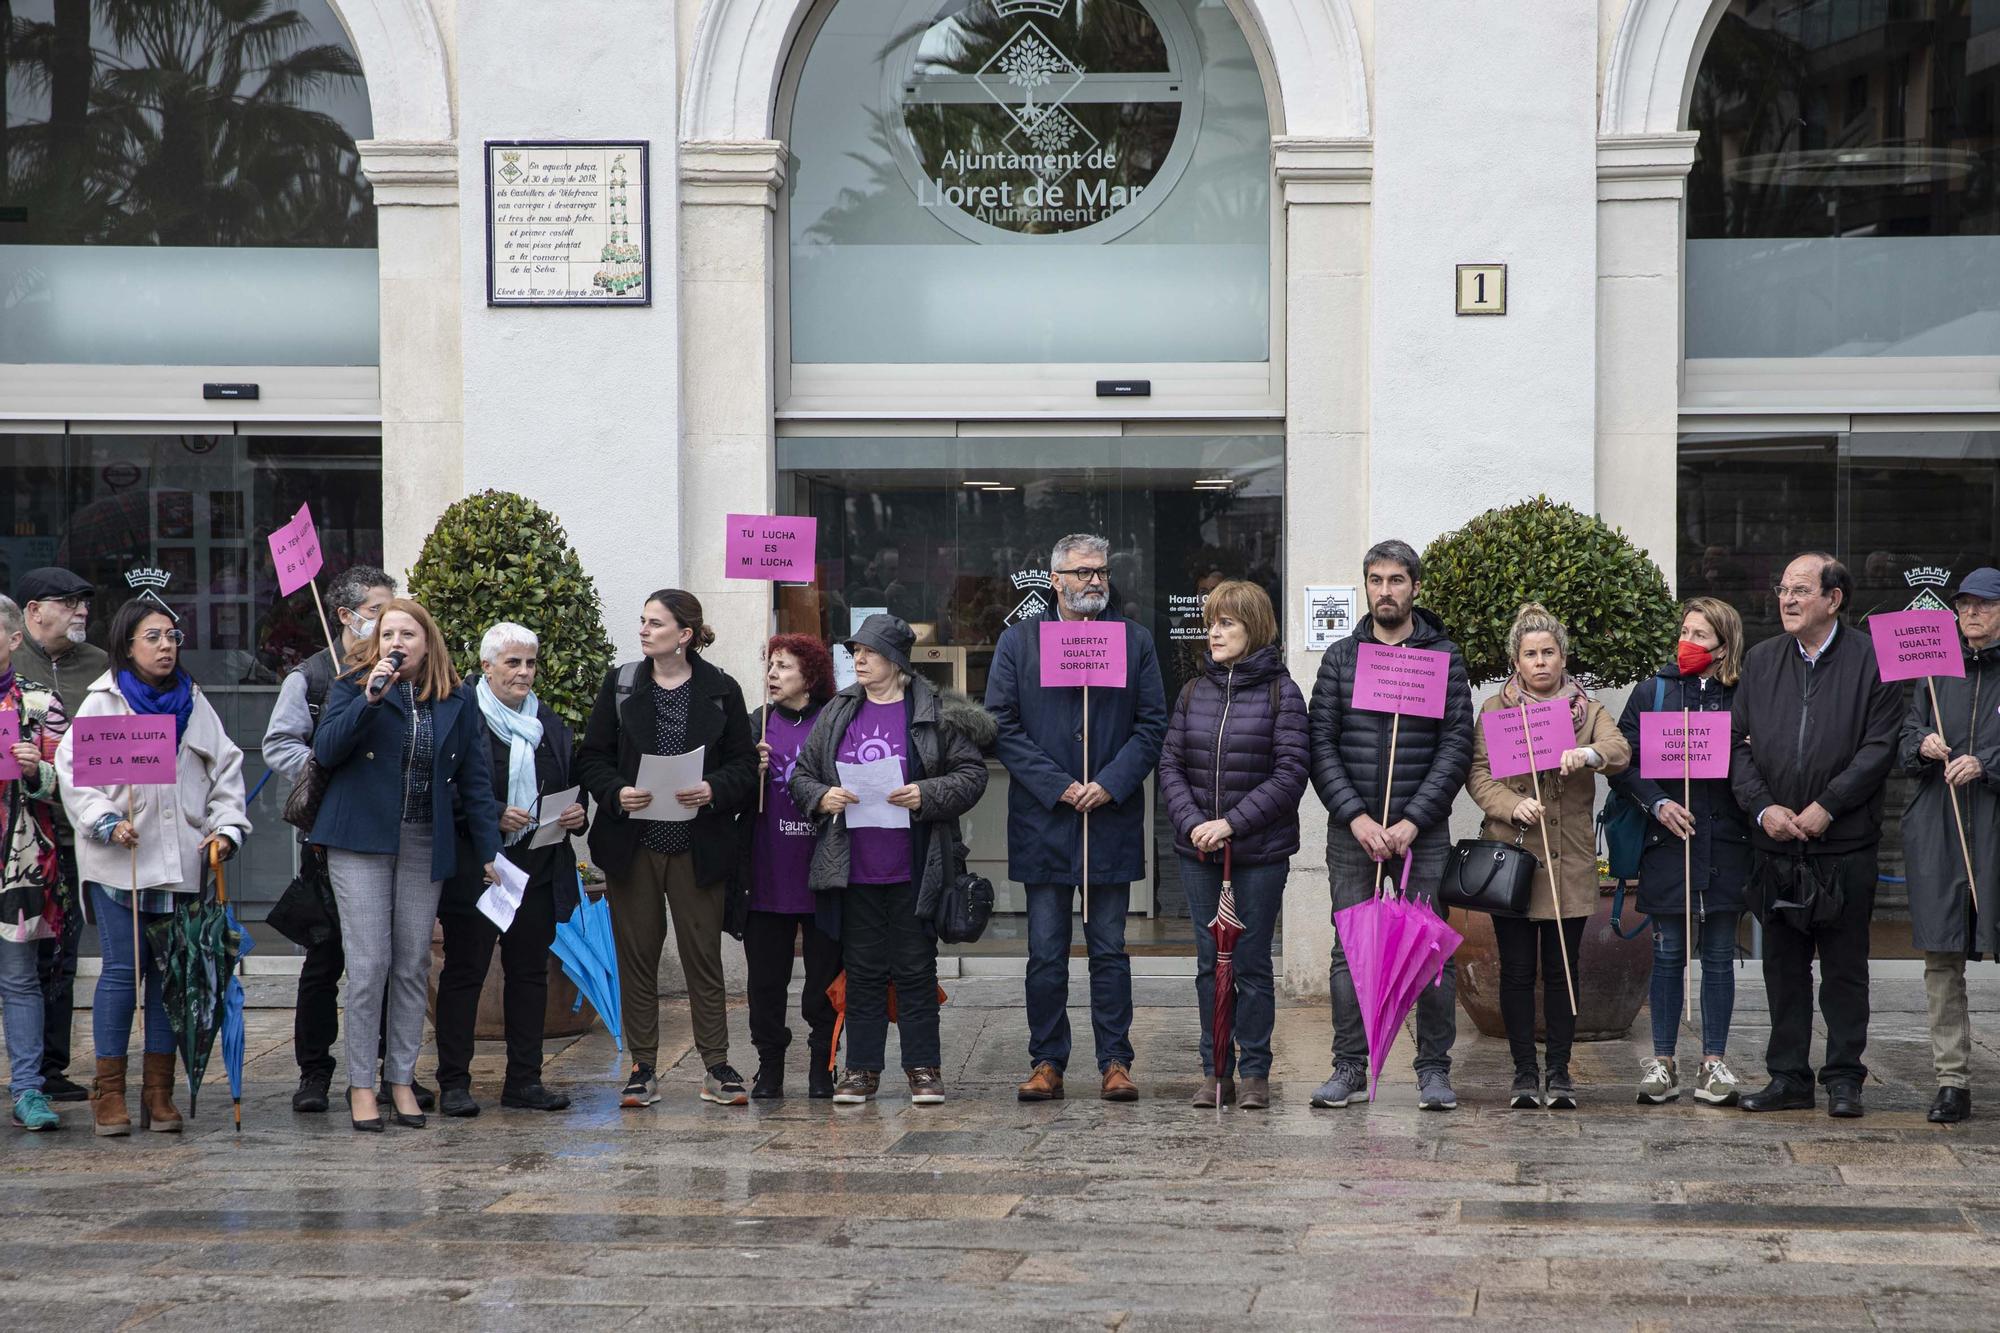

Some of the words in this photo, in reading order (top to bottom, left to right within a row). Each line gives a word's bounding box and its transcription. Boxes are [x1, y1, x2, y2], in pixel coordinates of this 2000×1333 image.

[941, 149, 1082, 175] Ajuntament
[1087, 148, 1116, 169] de
[542, 162, 572, 173] aquesta
[558, 188, 598, 198] Vilafranca
[917, 178, 1012, 207] Lloret
[1022, 178, 1064, 207] de
[1076, 178, 1144, 207] Mar
[514, 202, 545, 210] carregar
[554, 202, 598, 210] descarregar
[1474, 272, 1488, 304] 1
[742, 529, 754, 538] TU
[762, 530, 796, 540] LUCHA
[765, 544, 777, 552] ES
[742, 557, 752, 565] MI
[761, 558, 793, 567] LUCHA
[1170, 594, 1199, 604] Horari
[1894, 626, 1940, 636] LLIBERTAT
[1062, 637, 1108, 645] LLIBERTAT
[1899, 638, 1941, 649] IGUALTAT
[1408, 654, 1435, 662] MUJERES
[1898, 652, 1947, 662] SORORITAT
[1404, 668, 1435, 676] DERECHOS
[1498, 712, 1516, 720] TOTES
[1531, 706, 1551, 714] DONES
[1530, 720, 1550, 728] DRETS
[81, 734, 94, 742] LA
[100, 732, 126, 741] TEVA
[131, 732, 167, 740] LLUITA
[88, 756, 102, 766] ÉS
[110, 756, 123, 765] LA
[131, 756, 160, 764] MEVA
